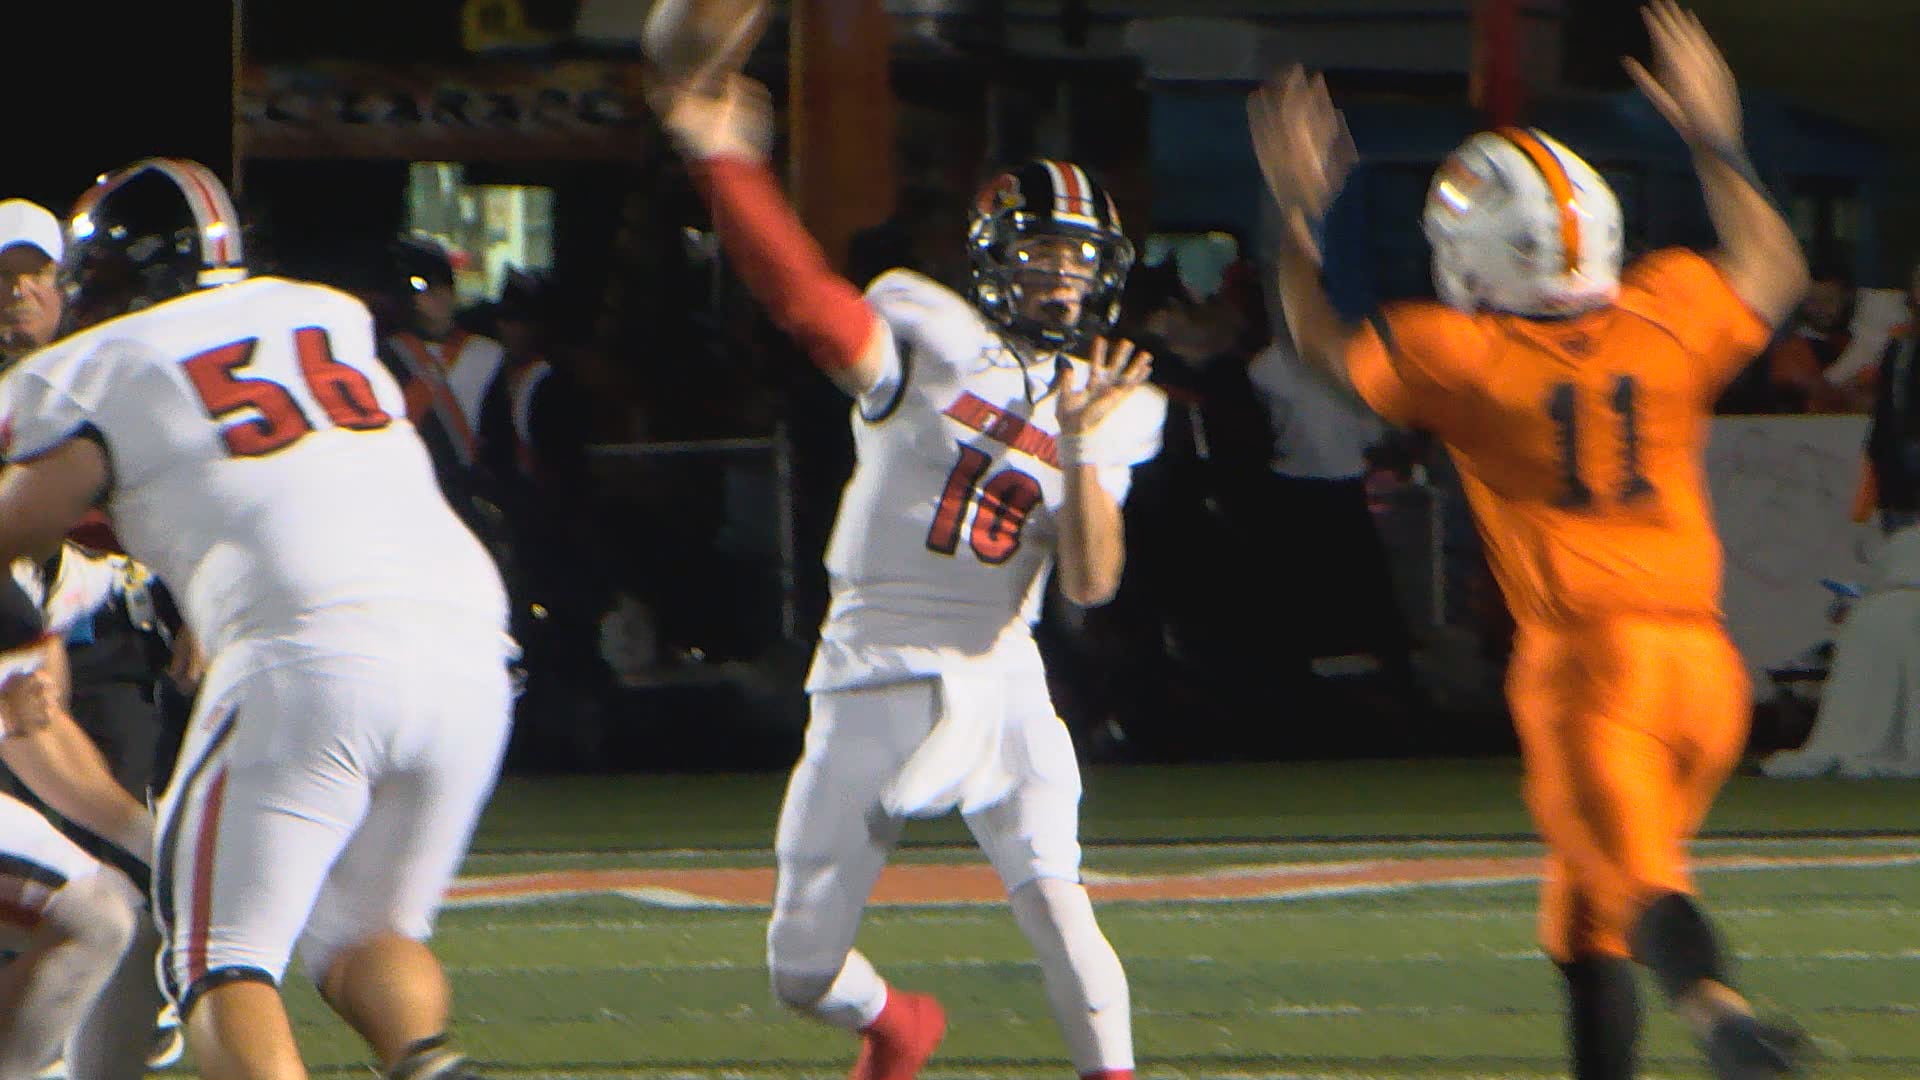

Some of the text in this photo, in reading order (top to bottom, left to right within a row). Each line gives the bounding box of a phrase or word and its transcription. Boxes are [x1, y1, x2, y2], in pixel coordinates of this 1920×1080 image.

[177, 327, 391, 457] 56
[1548, 374, 1656, 507] 11
[925, 438, 1044, 565] 10
